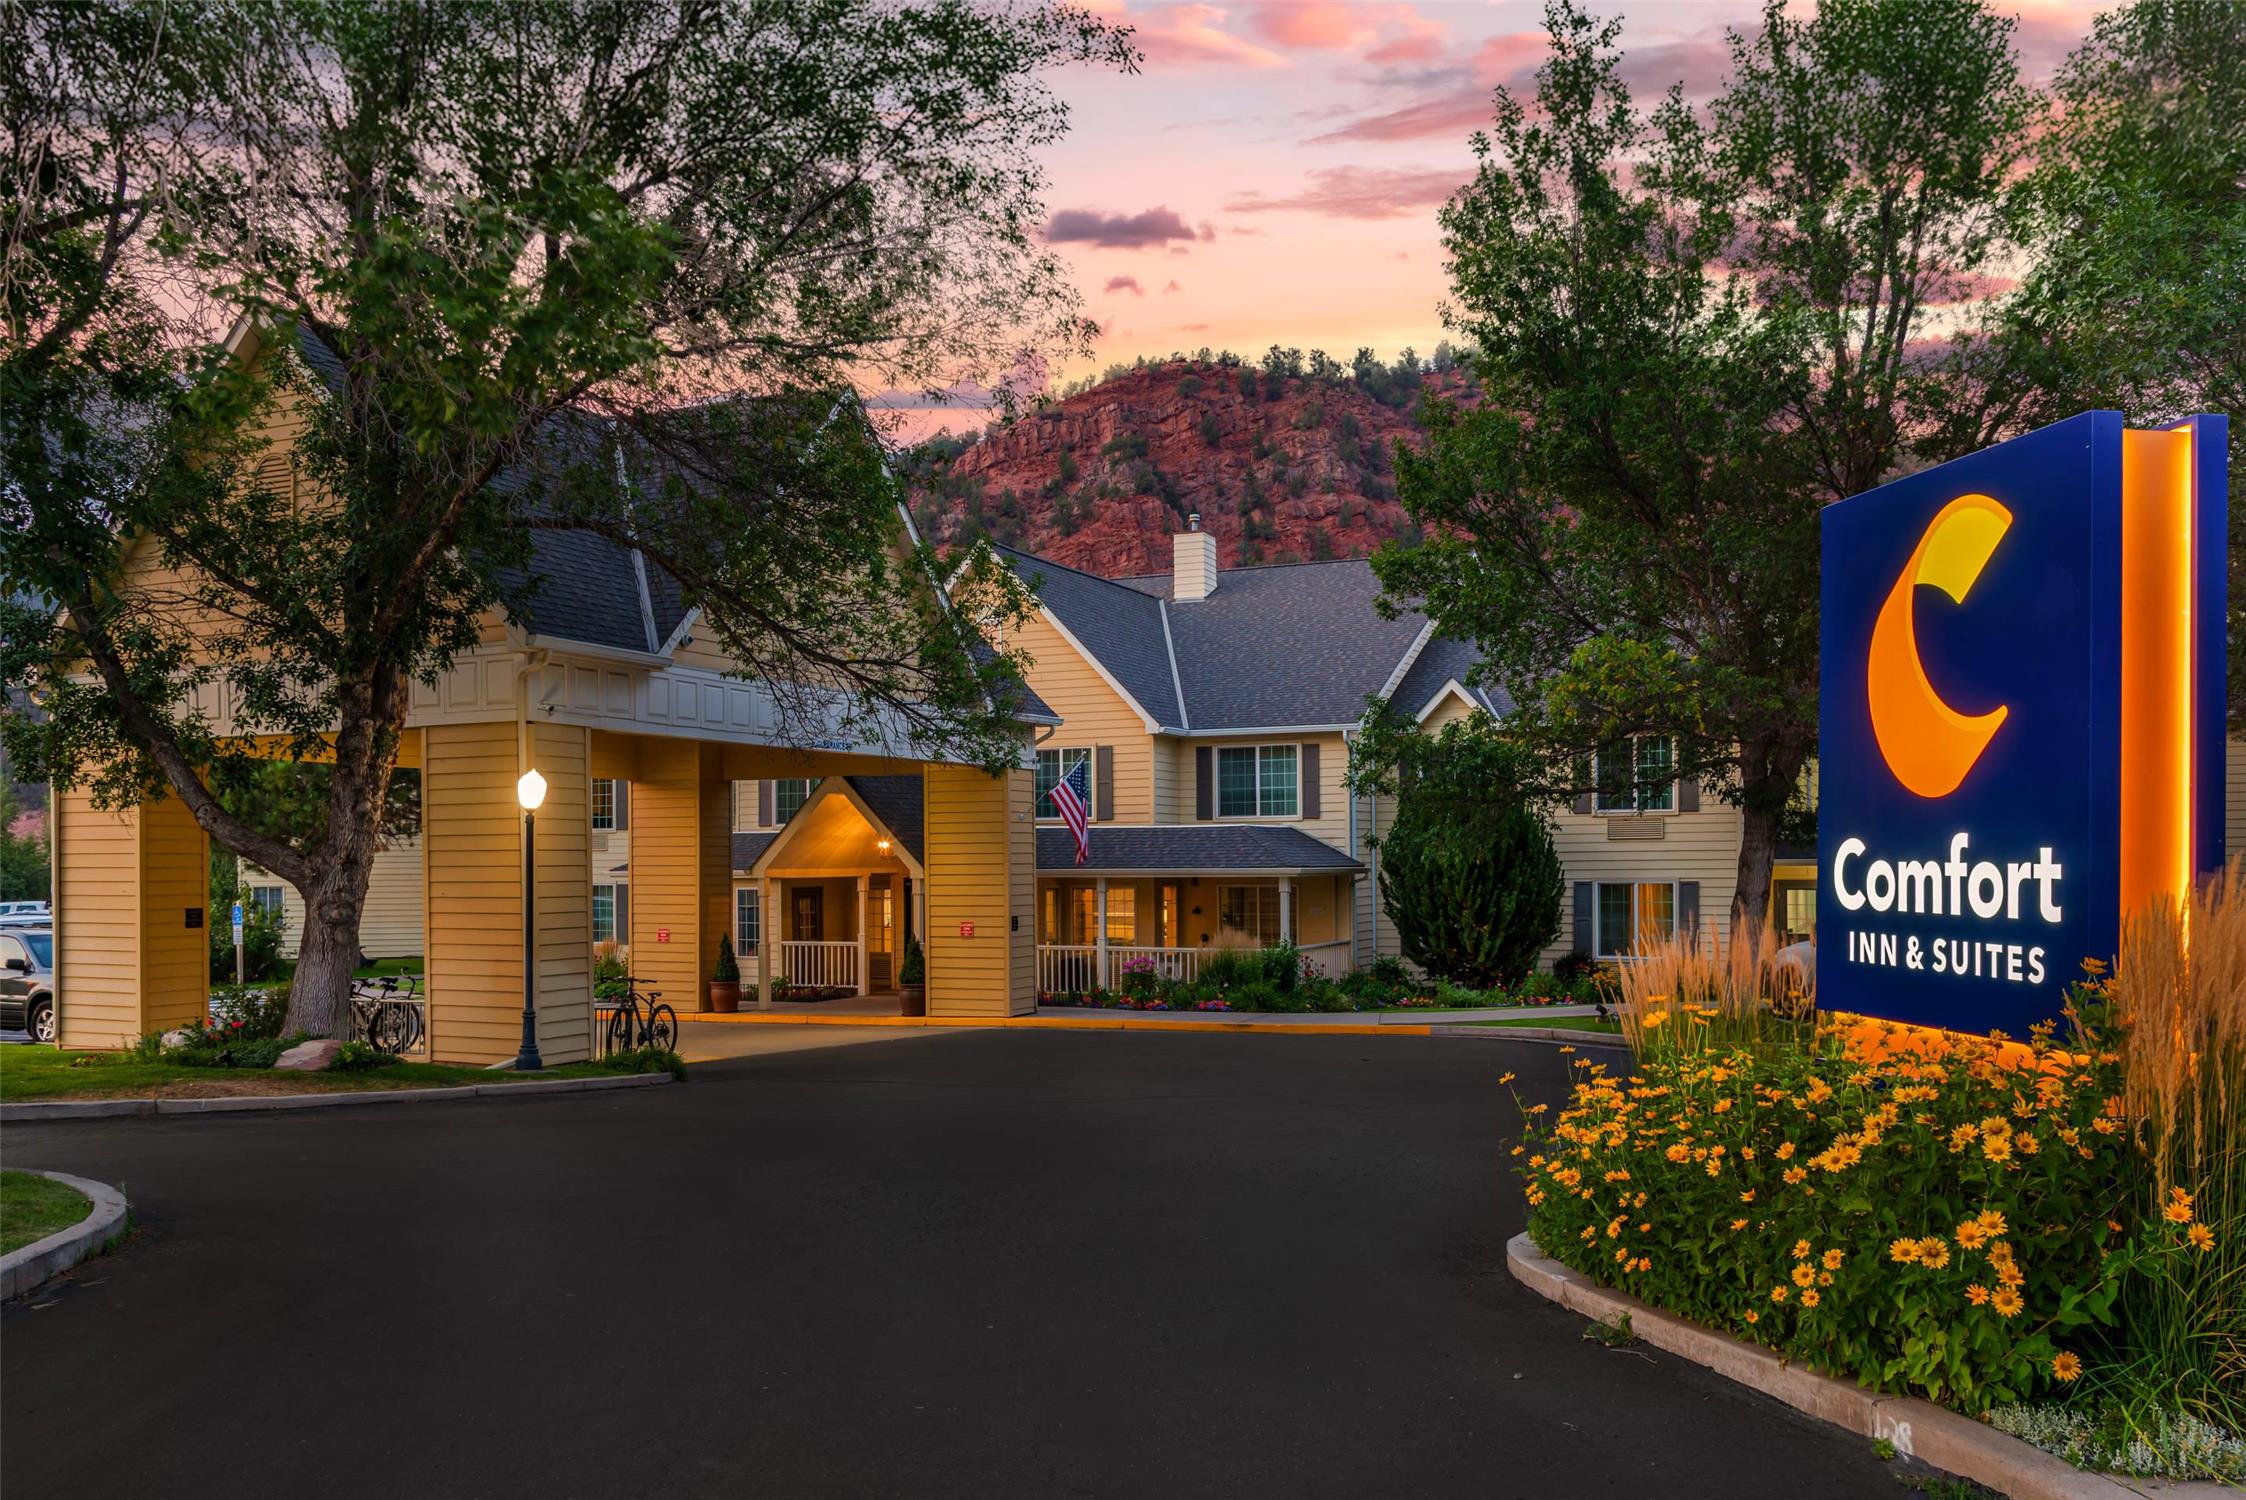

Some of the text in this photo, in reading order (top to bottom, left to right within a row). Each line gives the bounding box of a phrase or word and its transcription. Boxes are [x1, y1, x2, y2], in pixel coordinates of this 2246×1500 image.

[1834, 832, 2062, 922] Comfort
[1850, 931, 2045, 984] INN & SUITES
